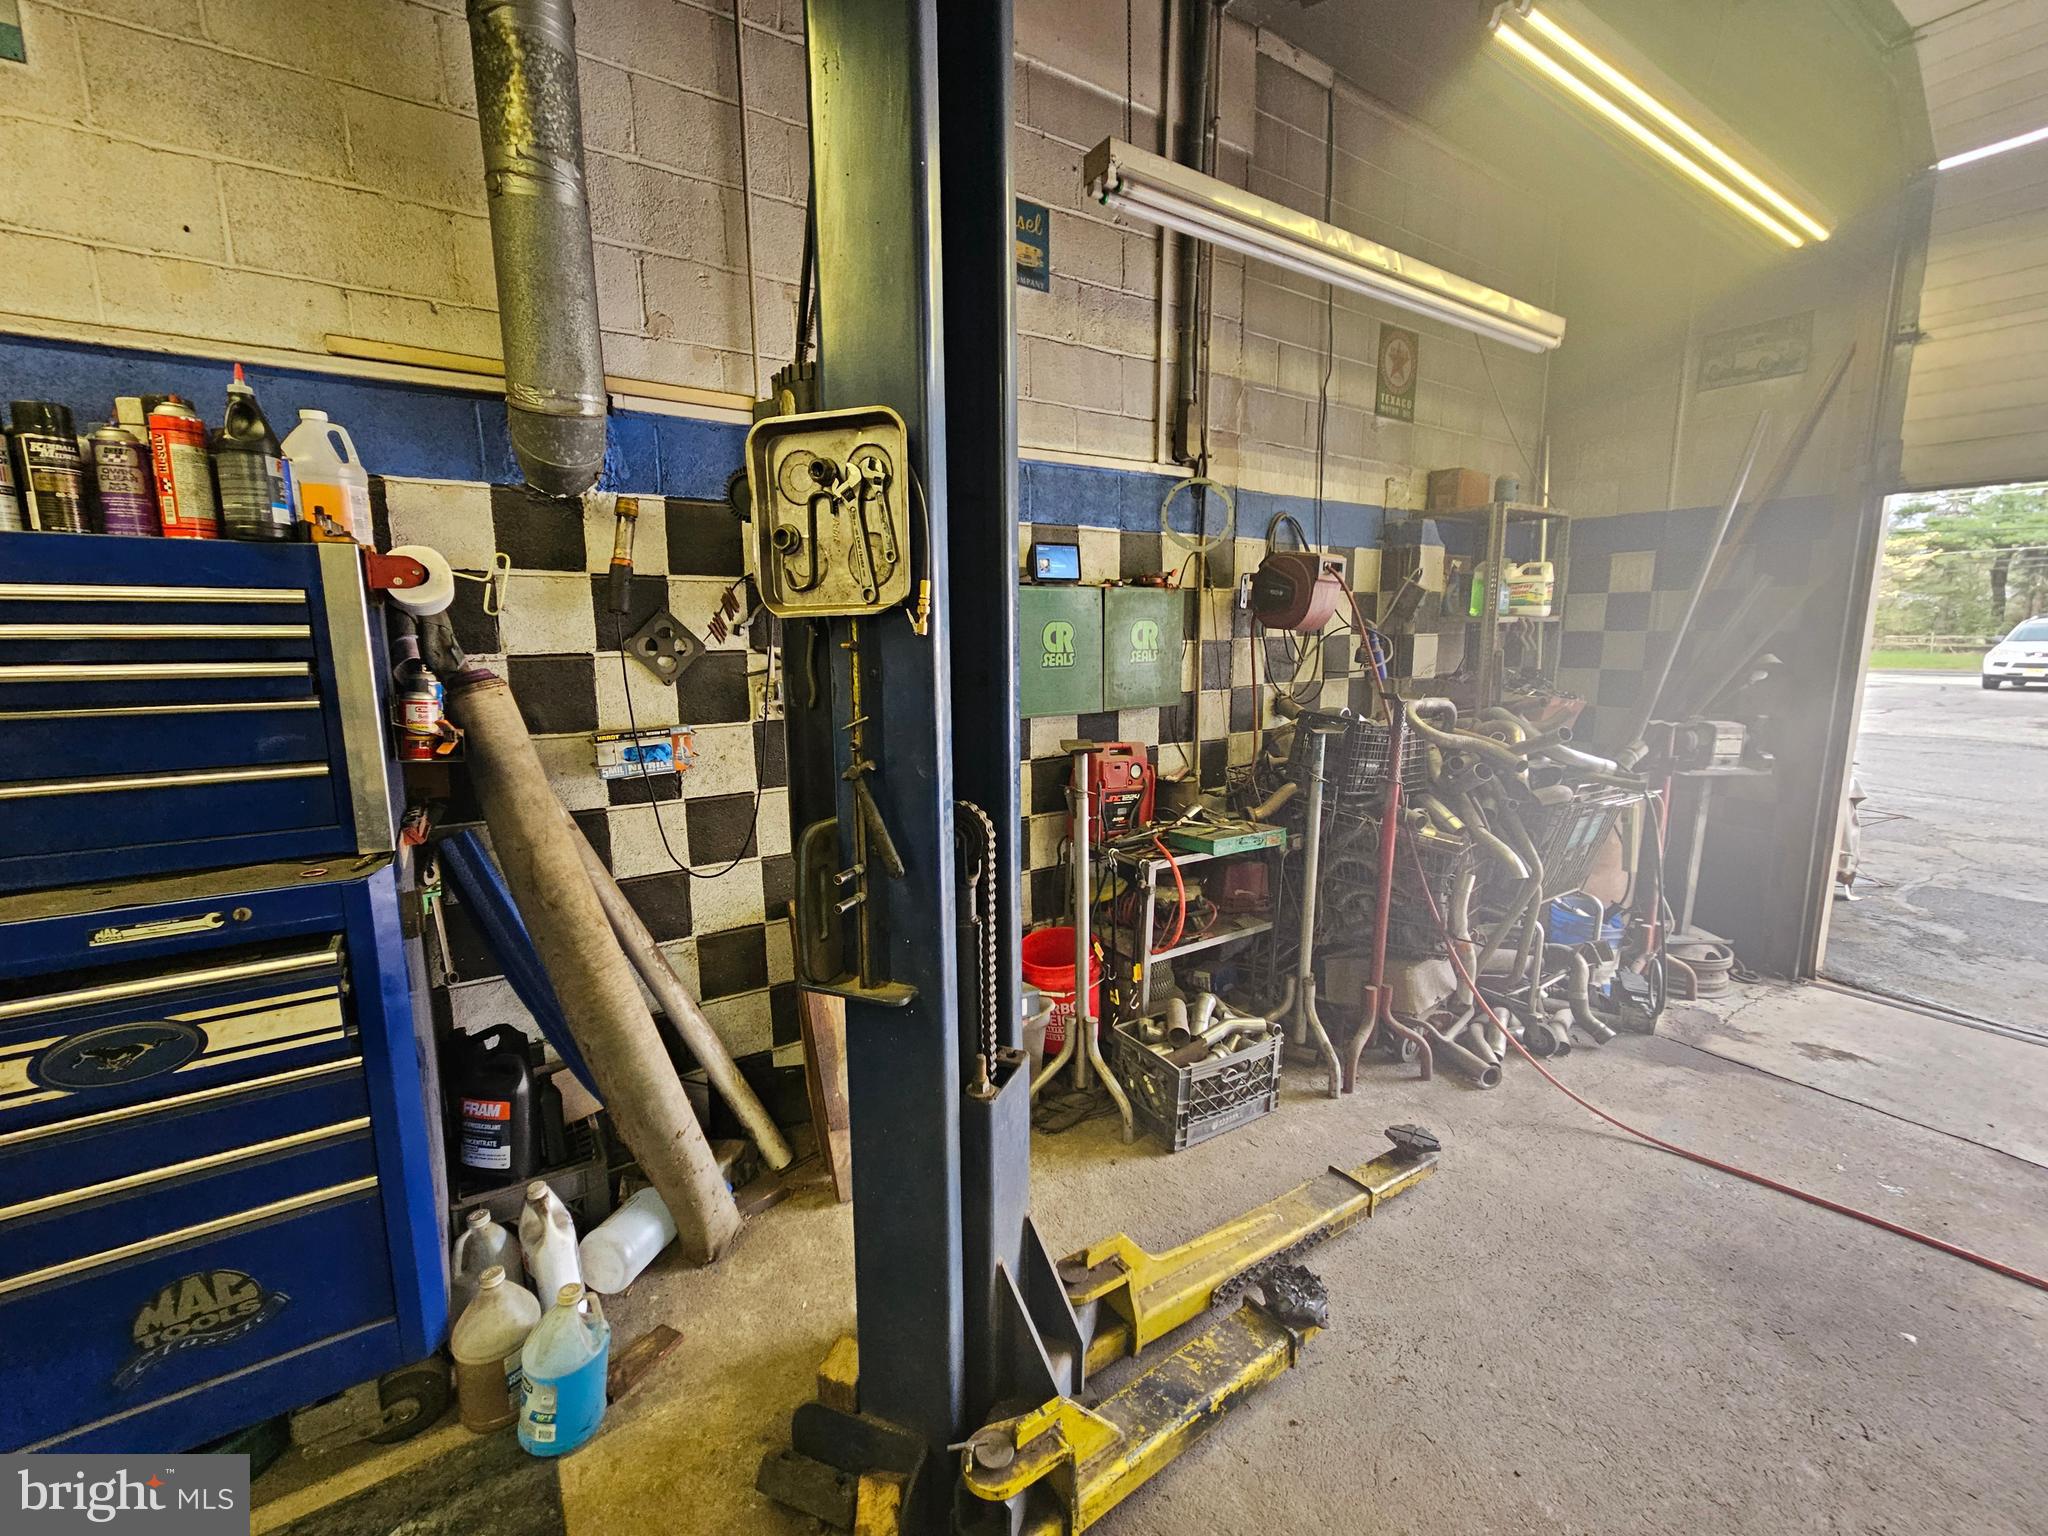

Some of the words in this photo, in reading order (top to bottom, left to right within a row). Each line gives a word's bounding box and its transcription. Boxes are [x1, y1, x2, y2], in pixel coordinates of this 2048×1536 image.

[1381, 393, 1413, 410] TEXACO
[1042, 621, 1075, 653] CR
[1130, 620, 1159, 650] CR
[1042, 652, 1075, 667] SEALS
[1130, 649, 1159, 664] SEALS
[464, 1101, 501, 1117] FRAM
[134, 1272, 258, 1338] MAC
[135, 1300, 262, 1348] TOOLS
